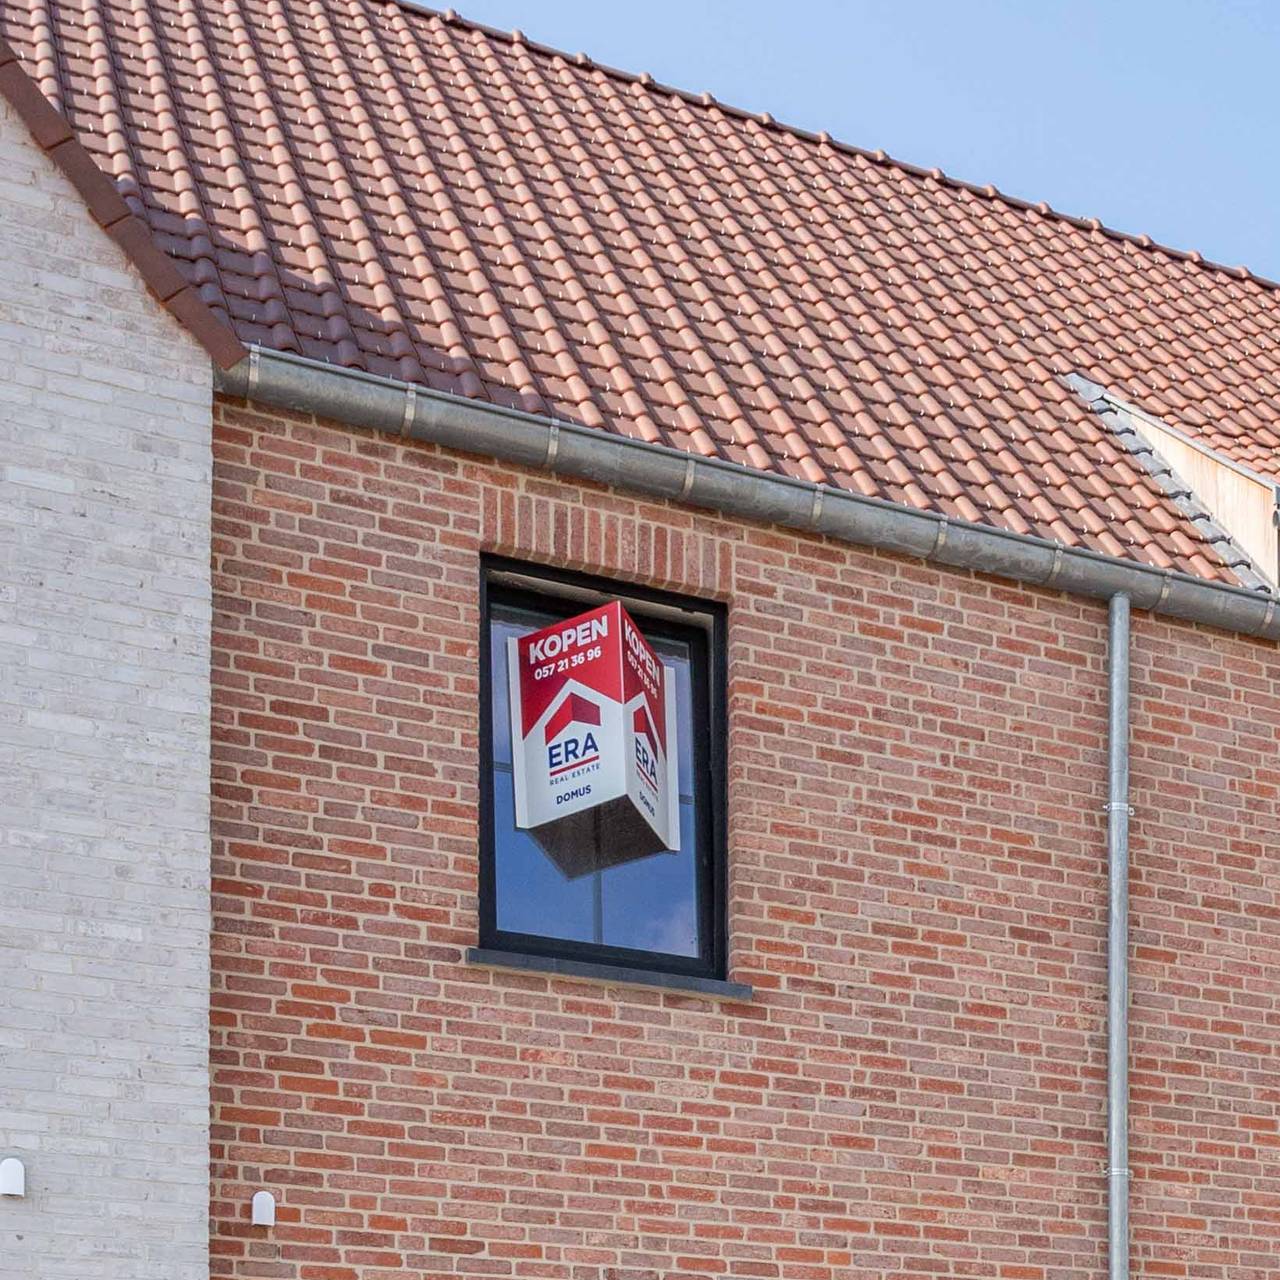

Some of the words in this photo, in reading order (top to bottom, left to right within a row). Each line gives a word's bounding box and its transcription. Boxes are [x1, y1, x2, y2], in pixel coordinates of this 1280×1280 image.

[529, 615, 608, 664] KOPEN
[624, 618, 660, 687] KOPEN
[534, 663, 556, 680] 057
[557, 658, 569, 672] 21
[570, 652, 585, 667] 36
[586, 646, 602, 661] 96
[548, 732, 599, 768] ERA
[635, 735, 658, 787] ERA
[549, 775, 569, 786] REAL
[571, 763, 600, 778] ESTATE
[556, 784, 592, 805] DOMUS
